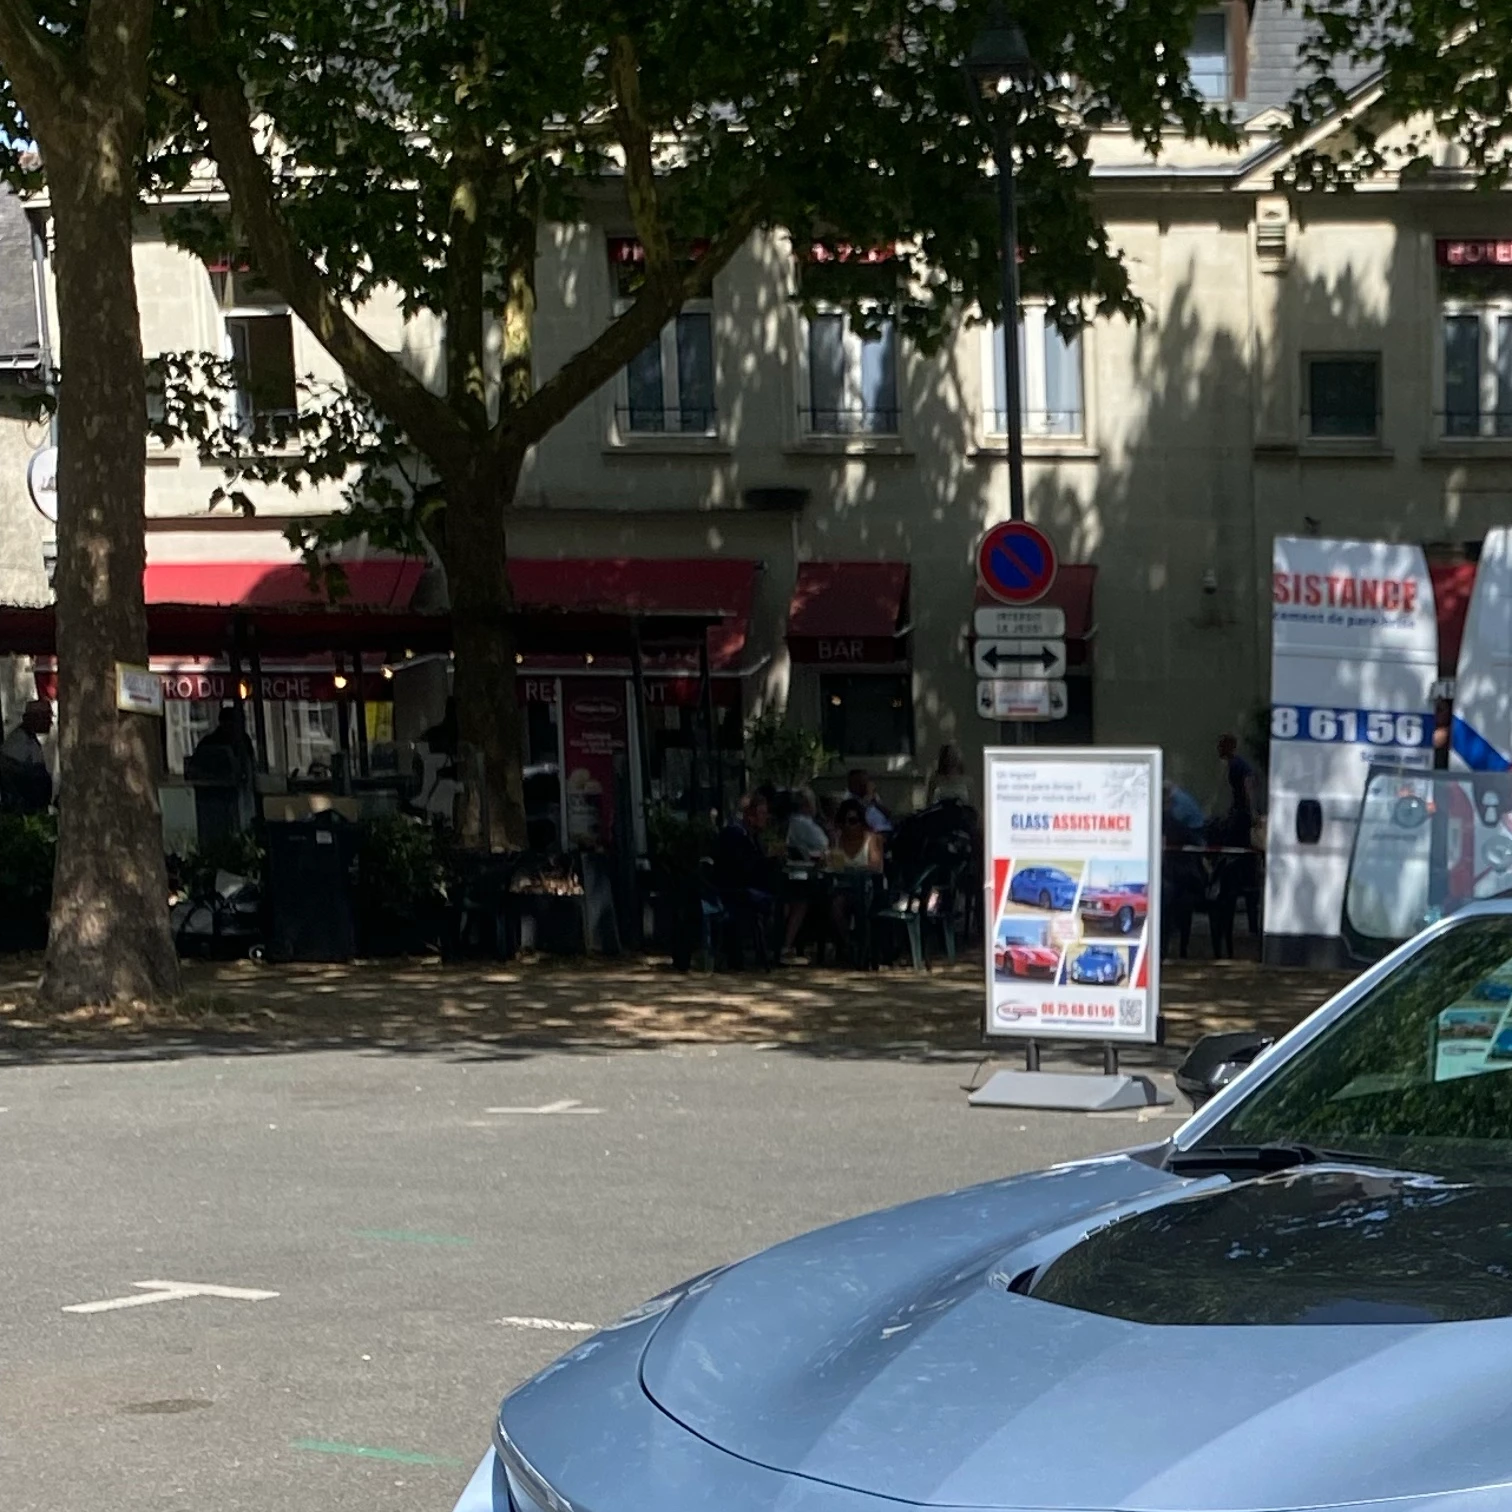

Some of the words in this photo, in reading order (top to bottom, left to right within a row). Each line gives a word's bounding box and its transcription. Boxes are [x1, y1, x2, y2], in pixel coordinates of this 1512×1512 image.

[818, 639, 865, 659] BAR
[197, 675, 224, 698] DU
[1308, 709, 1358, 742] 61
[1366, 712, 1424, 747] 56
